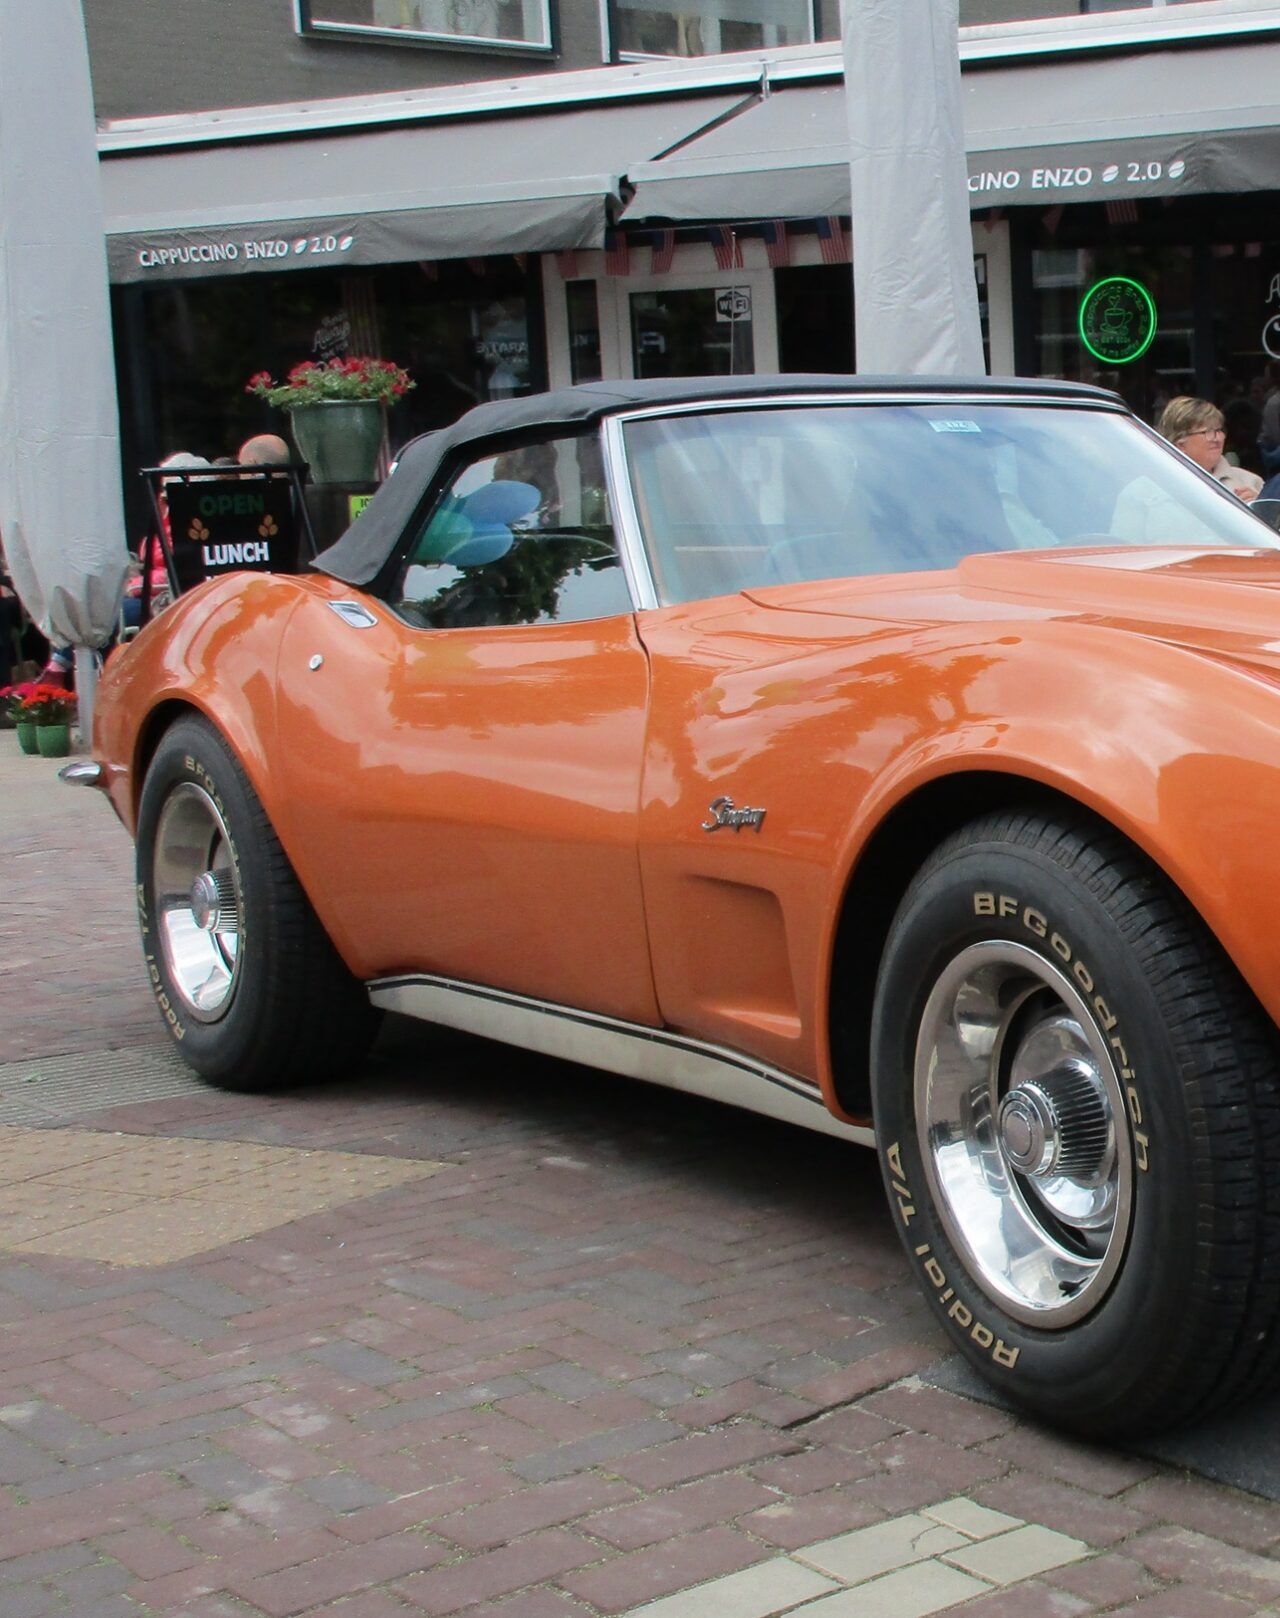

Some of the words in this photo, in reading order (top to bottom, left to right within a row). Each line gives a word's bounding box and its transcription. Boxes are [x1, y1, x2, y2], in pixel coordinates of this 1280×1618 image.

[1031, 166, 1093, 189] ENZO
[1127, 161, 1162, 182] 2.0
[139, 243, 238, 267] CAPPUCCINO
[246, 240, 289, 259] ENZO
[311, 236, 337, 253] 2.0
[200, 494, 265, 517] OPEN
[203, 541, 270, 566] LUNCH
[974, 892, 1150, 1172] BFGoodrich
[887, 1141, 916, 1227] T/A
[915, 1243, 1021, 1369] Radial
